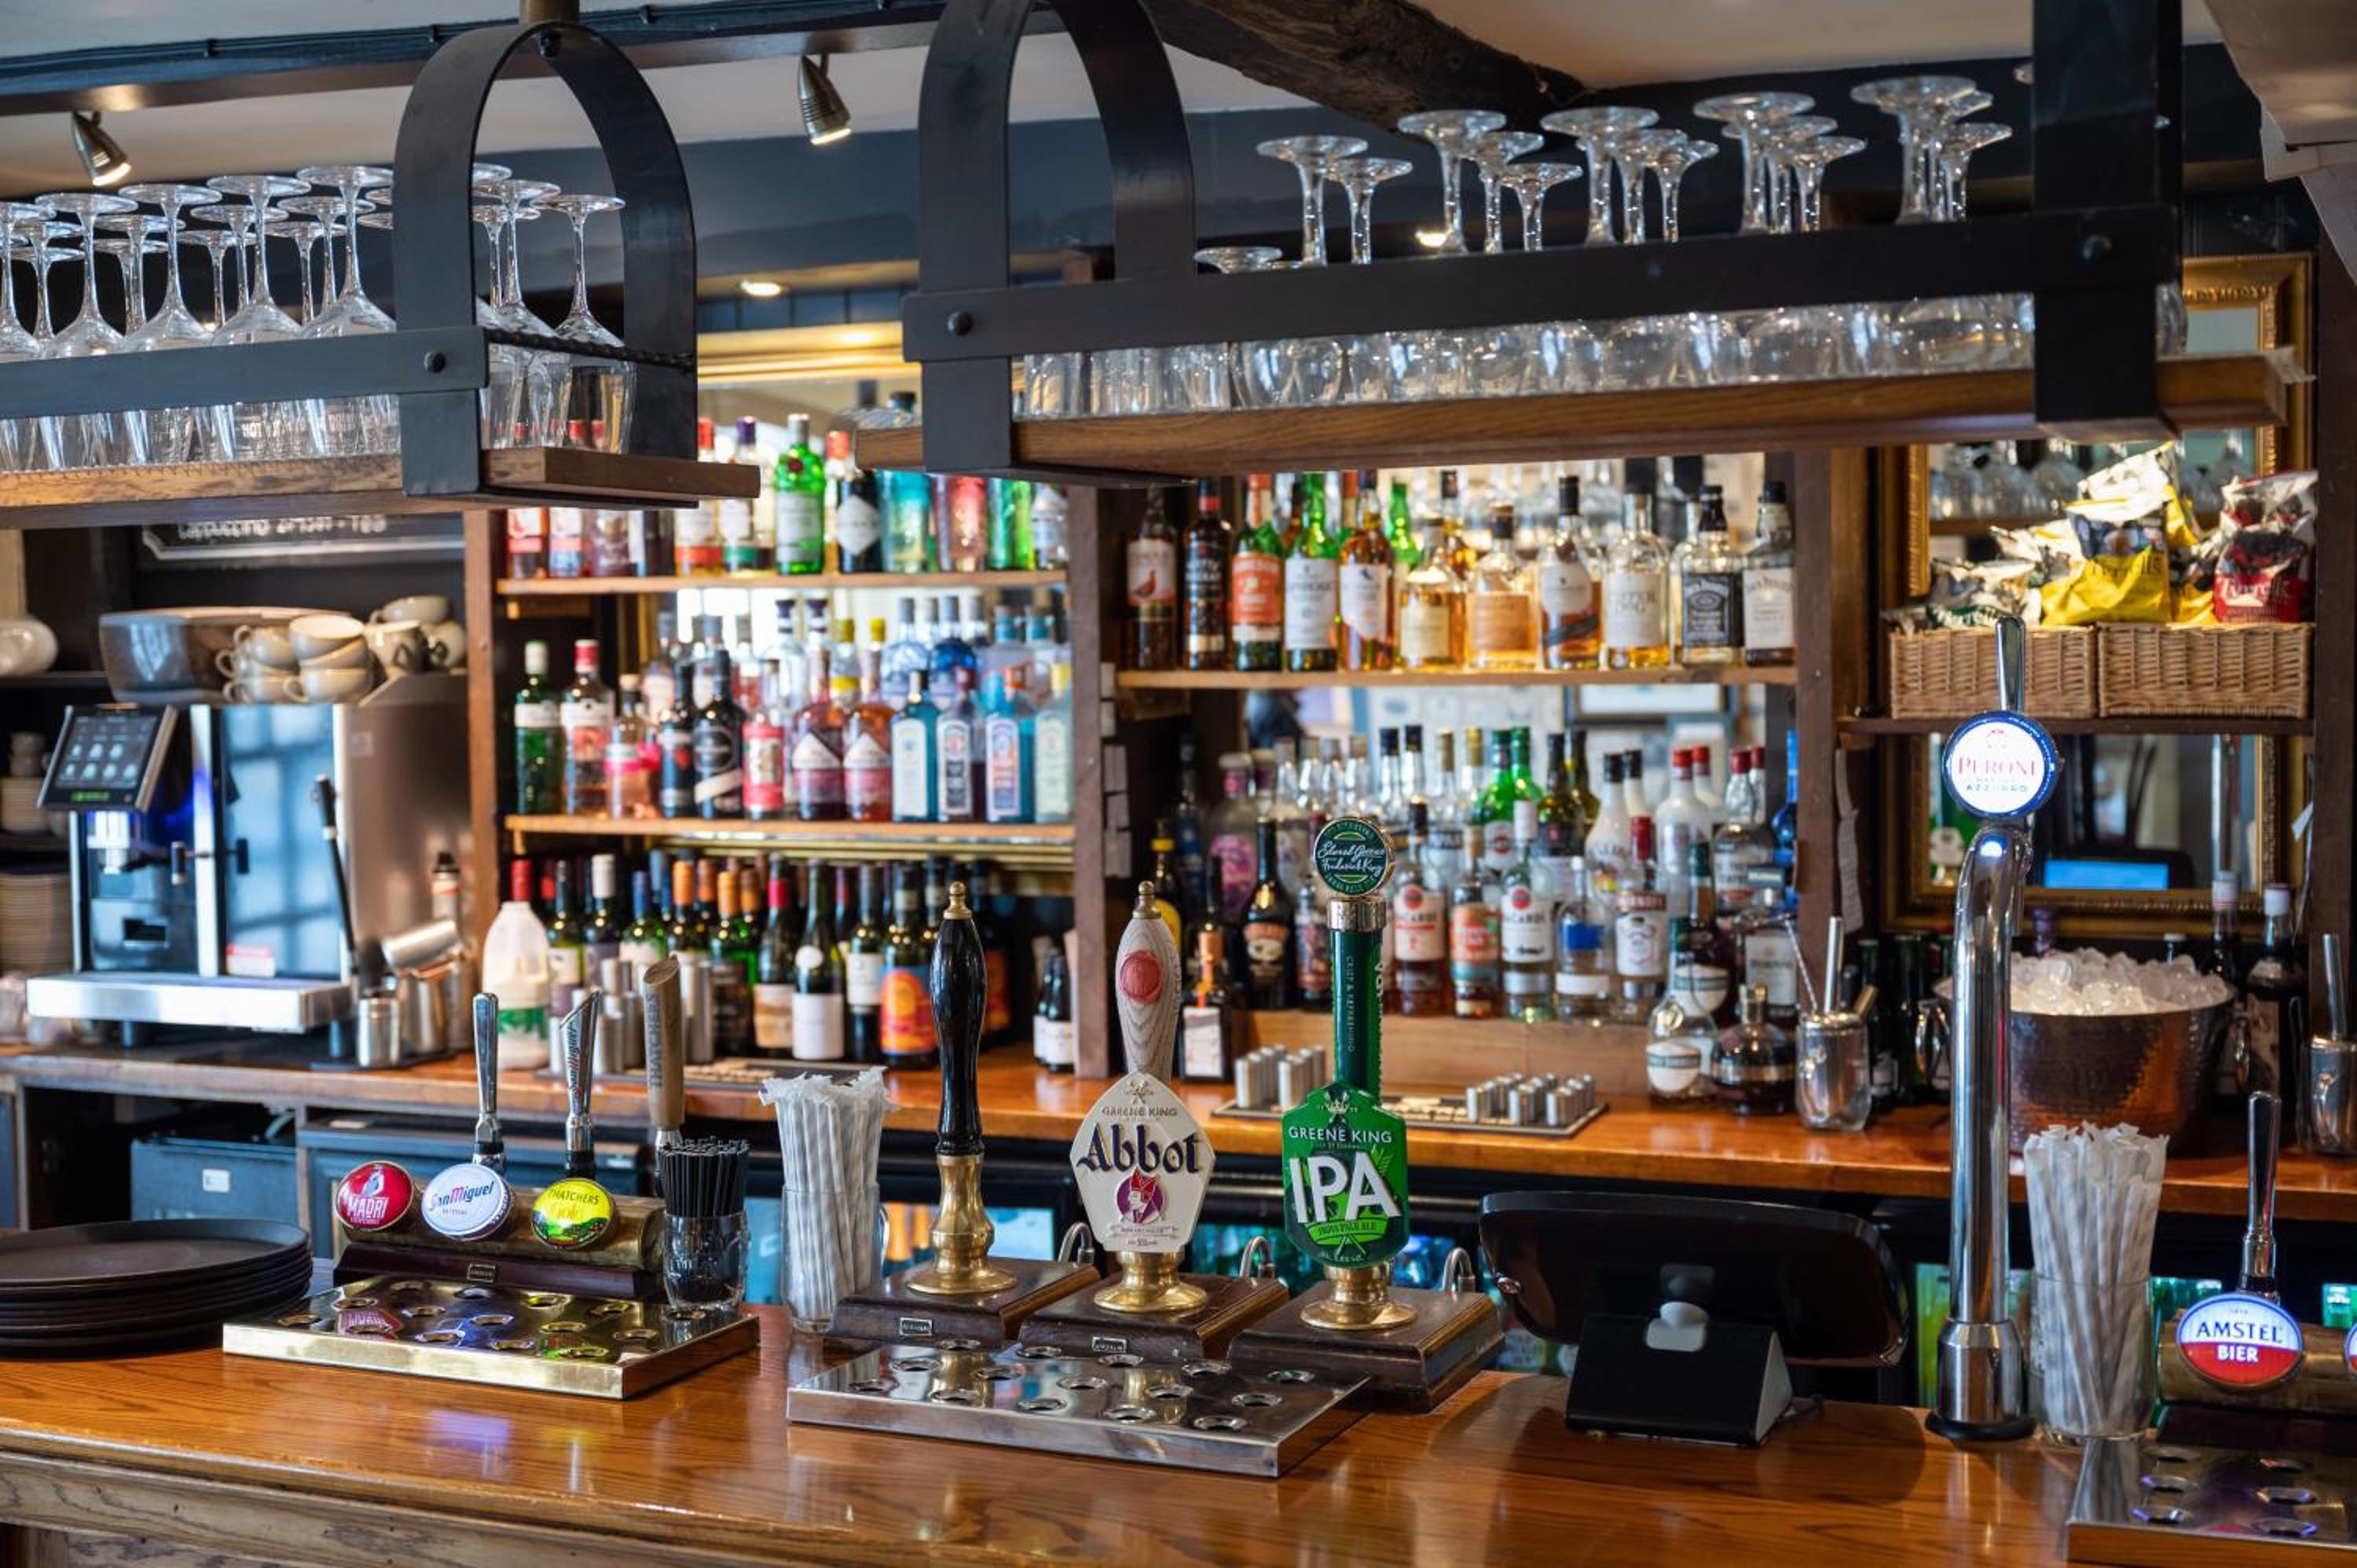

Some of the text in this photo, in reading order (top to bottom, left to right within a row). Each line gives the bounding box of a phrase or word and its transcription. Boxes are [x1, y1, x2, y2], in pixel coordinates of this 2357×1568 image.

[1959, 756, 2036, 776] PERONI
[1102, 1105, 1178, 1117] GREENE KING
[1288, 1126, 1392, 1143] GREENE KING
[1076, 1122, 1200, 1174] Abbot
[549, 1187, 600, 1206] THATCHERS
[1289, 1152, 1402, 1223] IPA
[2195, 1321, 2282, 1343] AMSTEL
[2217, 1344, 2259, 1363] BIER
